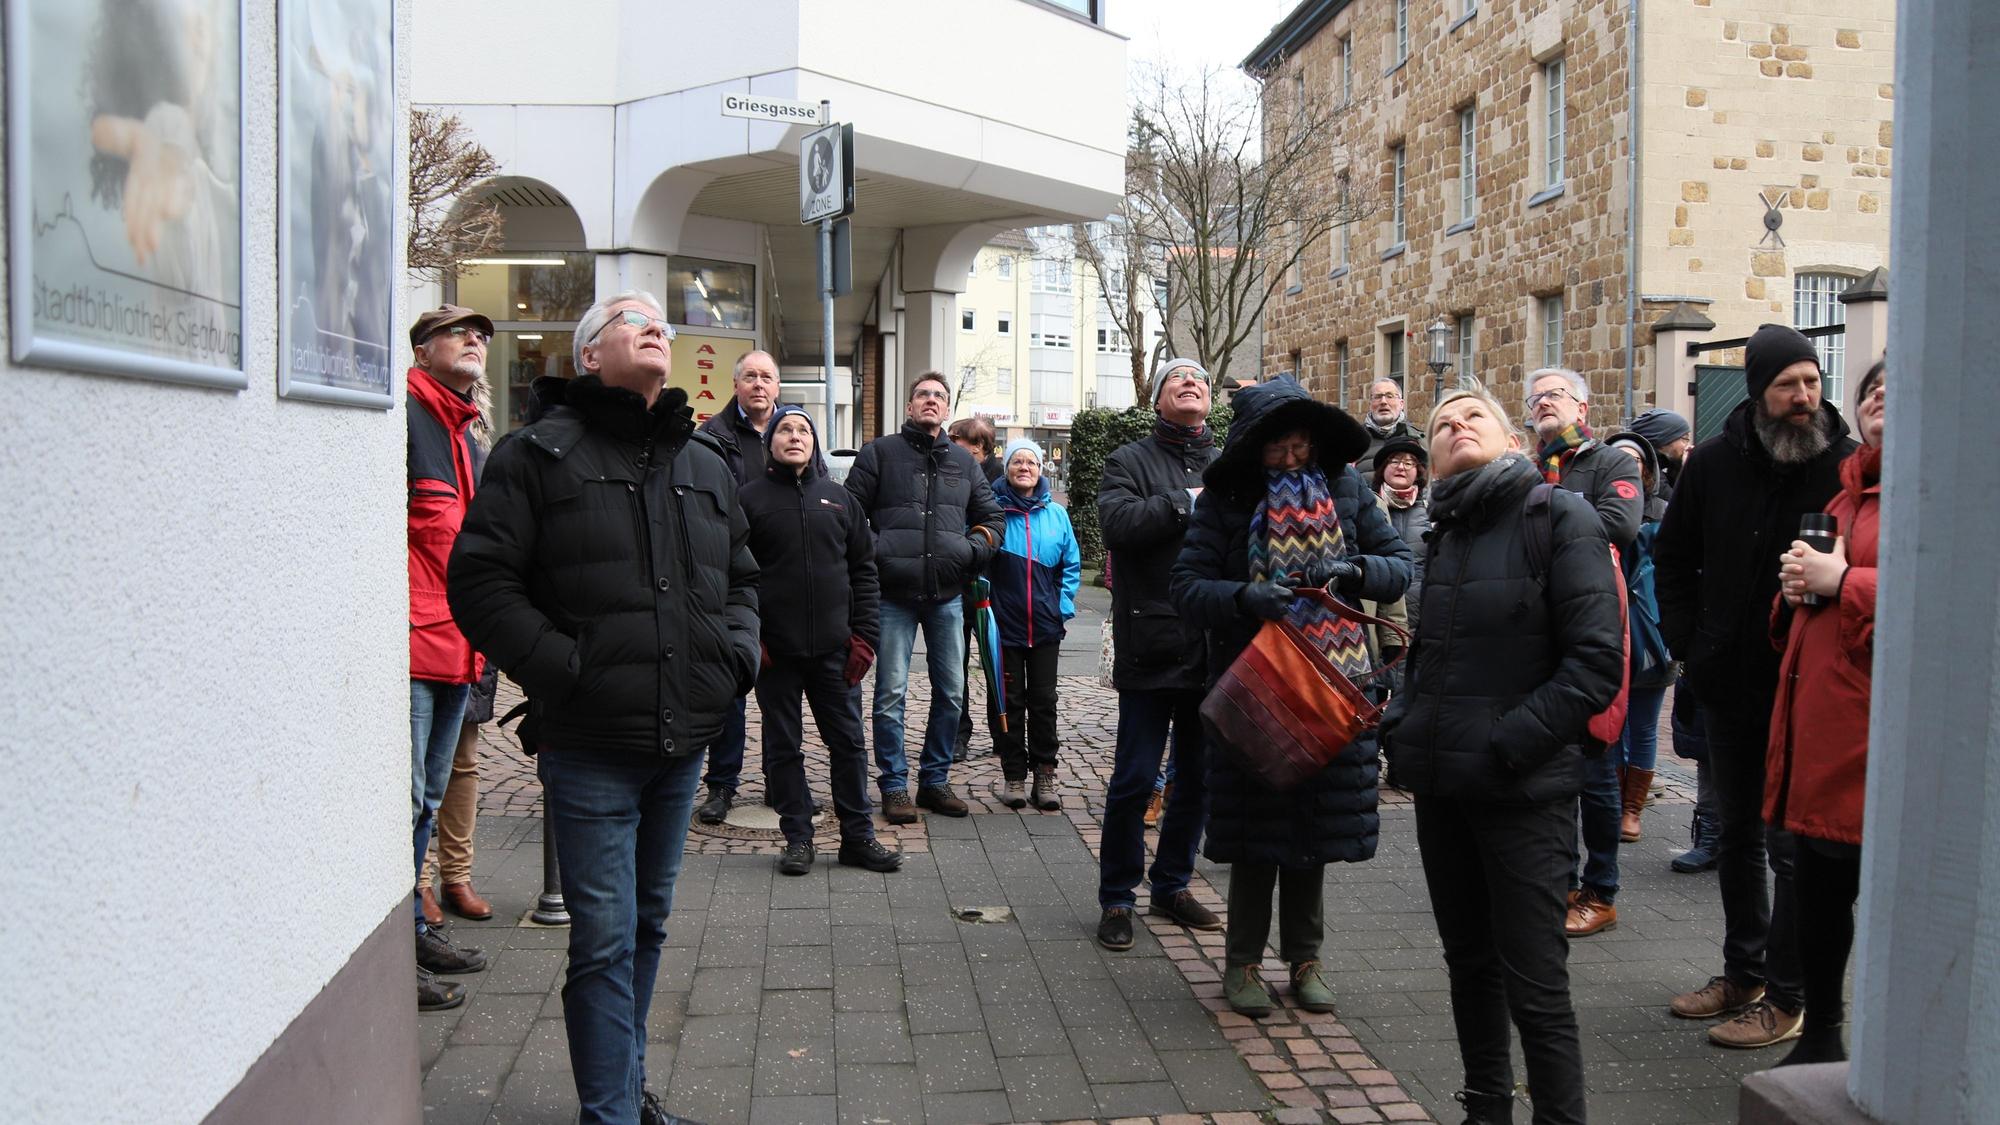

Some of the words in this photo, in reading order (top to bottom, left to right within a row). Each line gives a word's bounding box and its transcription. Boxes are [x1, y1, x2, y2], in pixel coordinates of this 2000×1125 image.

[726, 96, 816, 118] Griesgasse
[811, 195, 832, 214] ZONE
[176, 311, 241, 365] Siegburg
